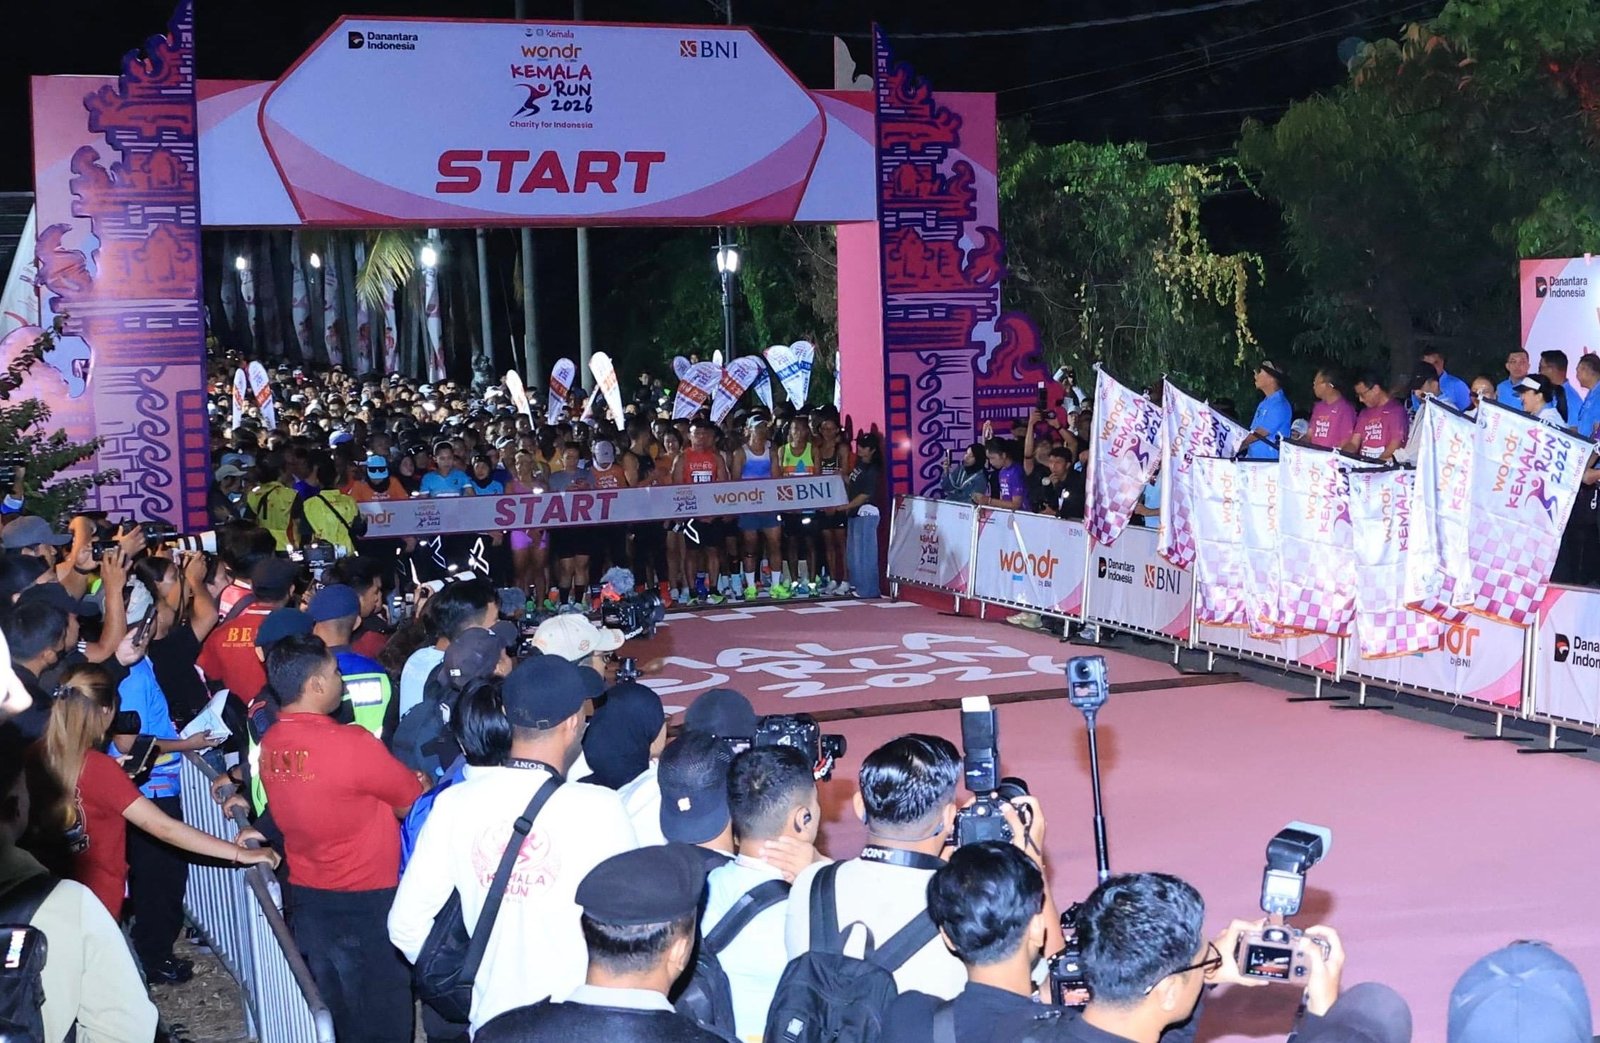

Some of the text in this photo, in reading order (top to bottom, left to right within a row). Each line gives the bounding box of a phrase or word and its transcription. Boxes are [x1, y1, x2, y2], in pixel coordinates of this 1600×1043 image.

[367, 31, 419, 42] Danantara
[367, 41, 416, 50] Indonesia
[546, 29, 575, 39] Kemala
[521, 43, 582, 59] wondr
[701, 40, 738, 59] BNI
[510, 63, 592, 80] KEMALA
[553, 80, 592, 97] RUN
[551, 96, 593, 114] 2026
[509, 120, 593, 130] Charity for Indonesia
[435, 149, 666, 194] START
[1549, 276, 1588, 287] Danantara
[1549, 287, 1586, 298] Indonesia
[1108, 398, 1146, 458] KEMALA
[1134, 404, 1155, 435] RUN
[1177, 410, 1211, 474] KEMALA
[1202, 416, 1220, 448] RUN
[1215, 421, 1231, 457] 2026
[1492, 430, 1519, 492] wondr
[1534, 432, 1557, 473] RUN
[1551, 437, 1572, 485] 2026
[1505, 426, 1543, 509] KEMALA
[713, 488, 767, 504] wondr
[796, 482, 833, 501] BNI
[1318, 457, 1339, 533] KEMALA
[494, 492, 618, 527] START
[1395, 473, 1410, 552] KEMALA
[1000, 548, 1059, 580] wondr
[1156, 566, 1181, 595] BNI
[735, 646, 1032, 680] RUN
[513, 760, 545, 770] SONY
[861, 847, 895, 860] SONY
[504, 884, 529, 898] UN
